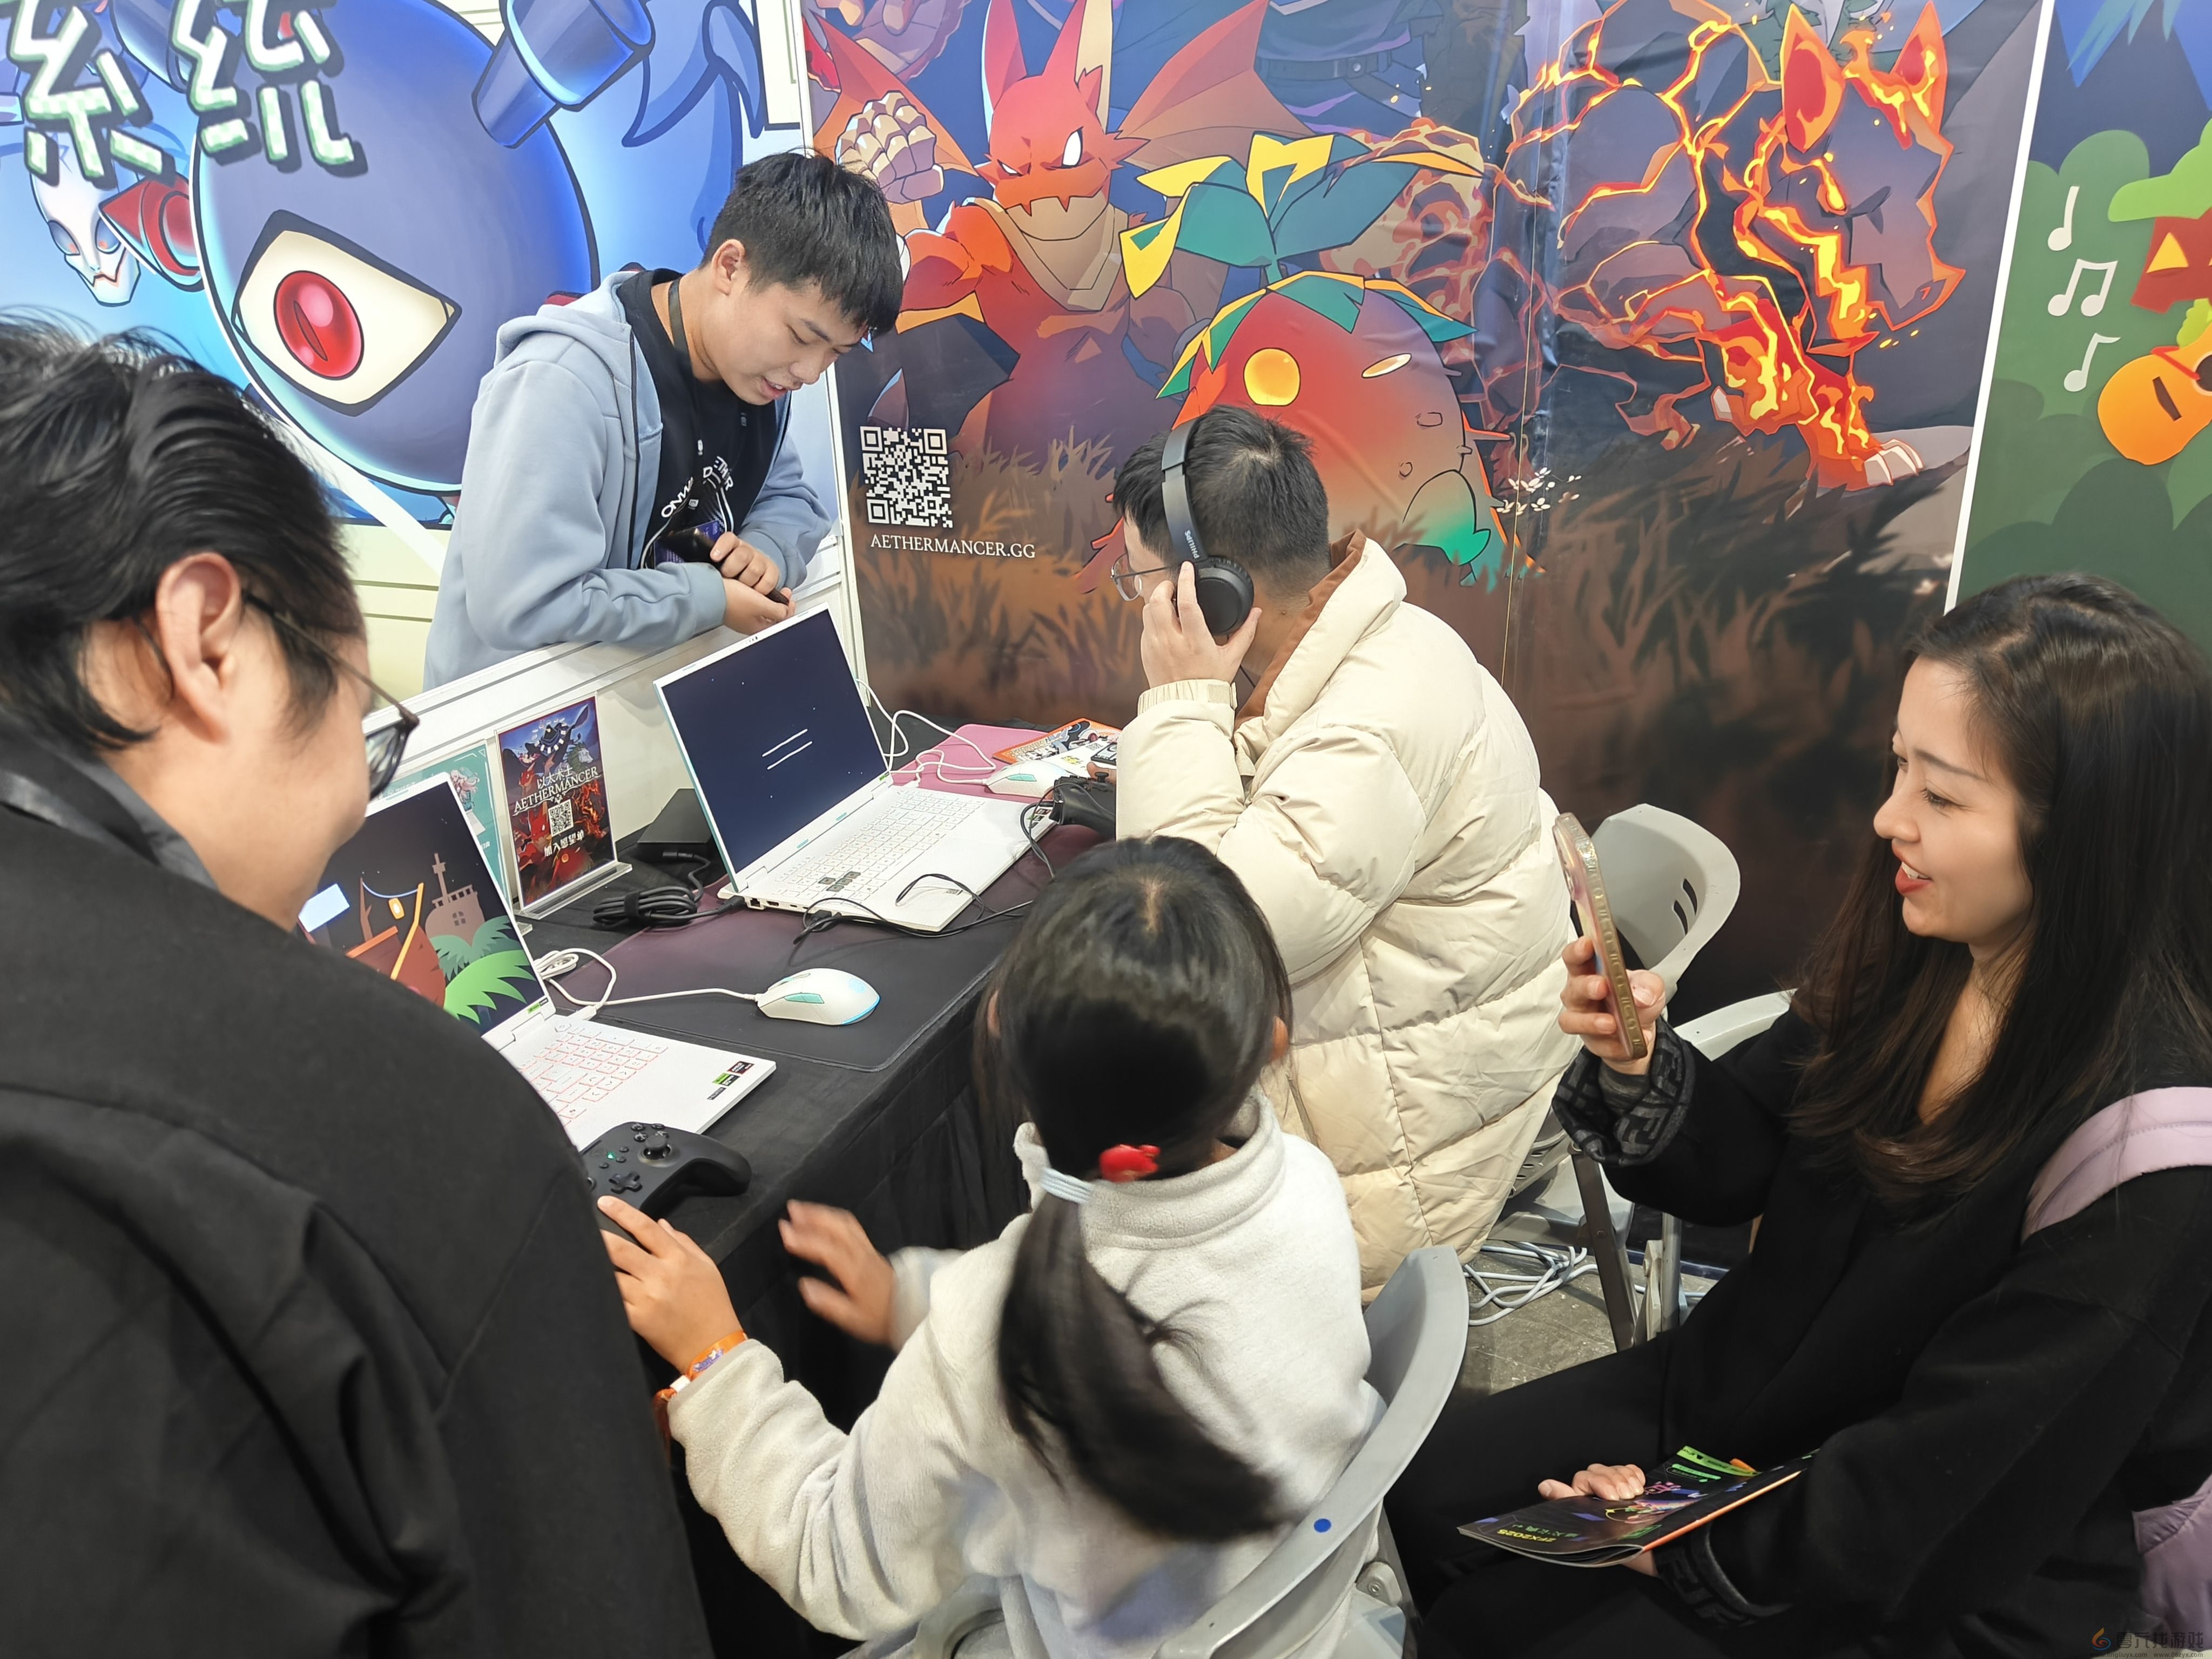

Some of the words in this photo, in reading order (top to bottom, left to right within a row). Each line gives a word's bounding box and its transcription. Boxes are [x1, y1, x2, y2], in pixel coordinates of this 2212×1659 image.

[870, 534, 1036, 558] AETHERMANCER.GG
[1184, 530, 1199, 559] PHILIPS
[514, 766, 599, 811] AETHERMANCER
